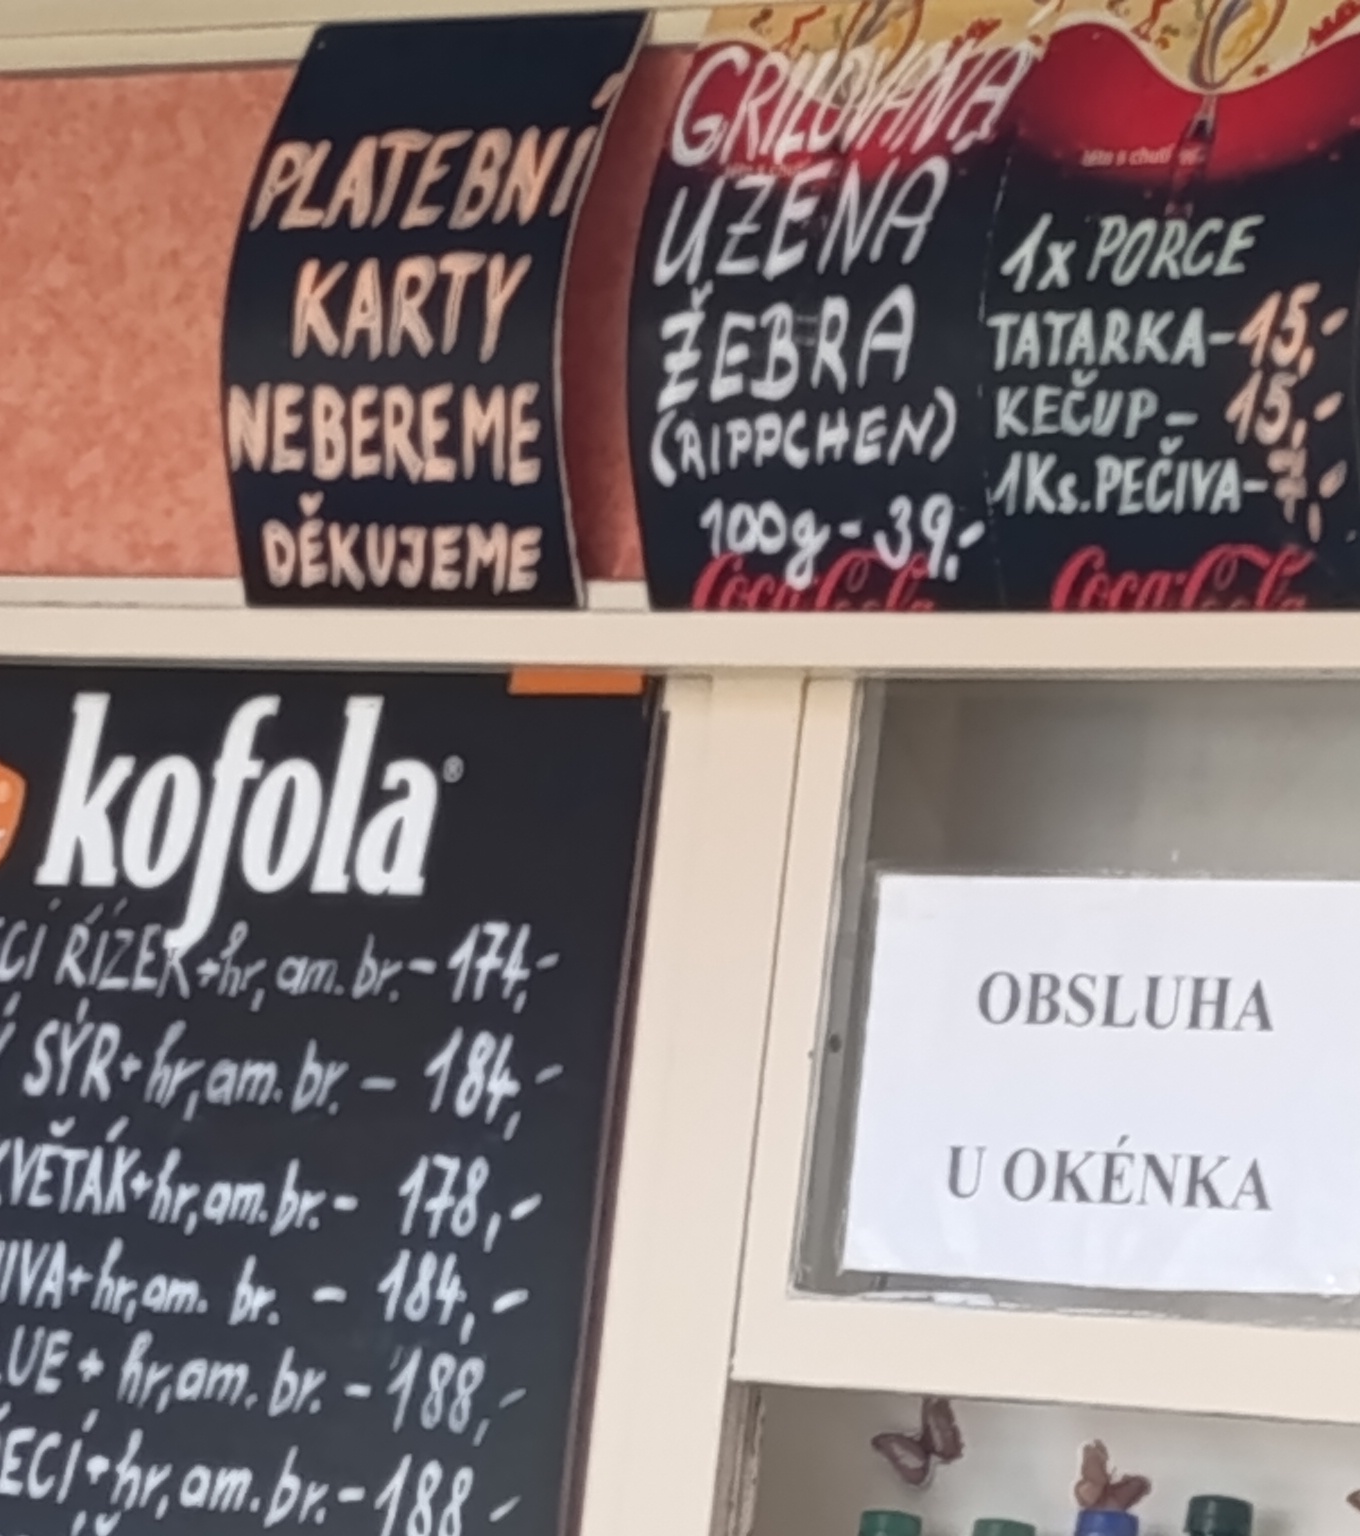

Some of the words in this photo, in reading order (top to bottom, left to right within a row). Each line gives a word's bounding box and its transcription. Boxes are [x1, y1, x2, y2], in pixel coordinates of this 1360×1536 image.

[249, 72, 625, 231] PLATEBNÍ
[1001, 214, 1075, 291] 1x
[1087, 214, 1265, 286] PORCE
[292, 252, 531, 362] KARTY
[658, 281, 916, 411] ŽEBRA
[228, 381, 541, 486] NEBEREME
[650, 386, 956, 486] (RIPPCHEN)
[261, 492, 542, 594] DĚKUJEME
[700, 499, 830, 590] 100g
[35, 692, 439, 949] kofola
[976, 969, 1275, 1035] OBSLUHA
[944, 1144, 990, 1201] U
[1003, 1133, 1274, 1213] OKÉNKA
